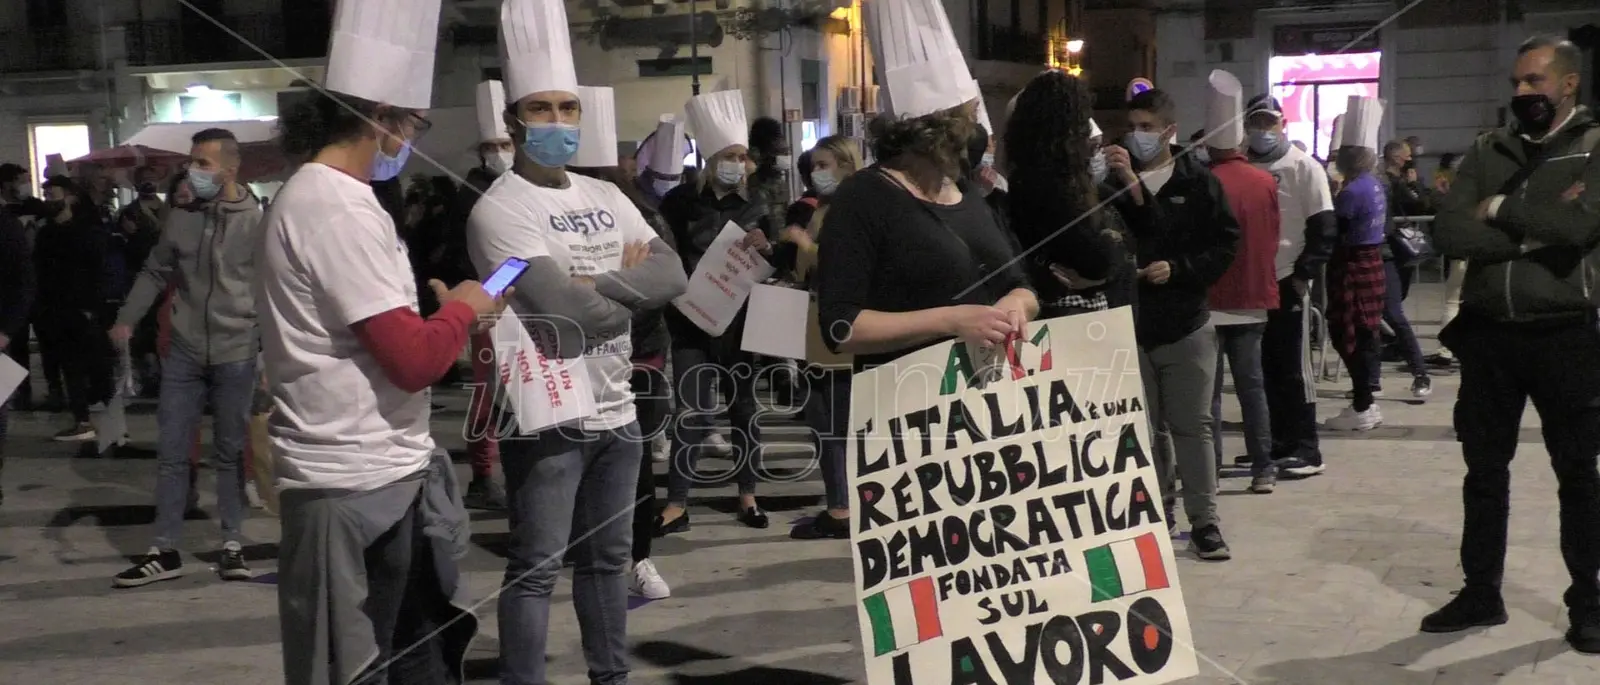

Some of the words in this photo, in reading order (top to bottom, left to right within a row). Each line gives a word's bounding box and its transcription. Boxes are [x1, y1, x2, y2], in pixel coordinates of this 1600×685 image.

[550, 210, 615, 233] GUSTO
[515, 349, 534, 385] NON
[560, 369, 573, 390] UN
[1103, 397, 1143, 417] UNA
[856, 423, 1150, 534] REPUBBLICA
[857, 477, 1163, 591] DEMOCRATICA
[939, 549, 1073, 601] FONDATA
[977, 589, 1048, 624] SUL
